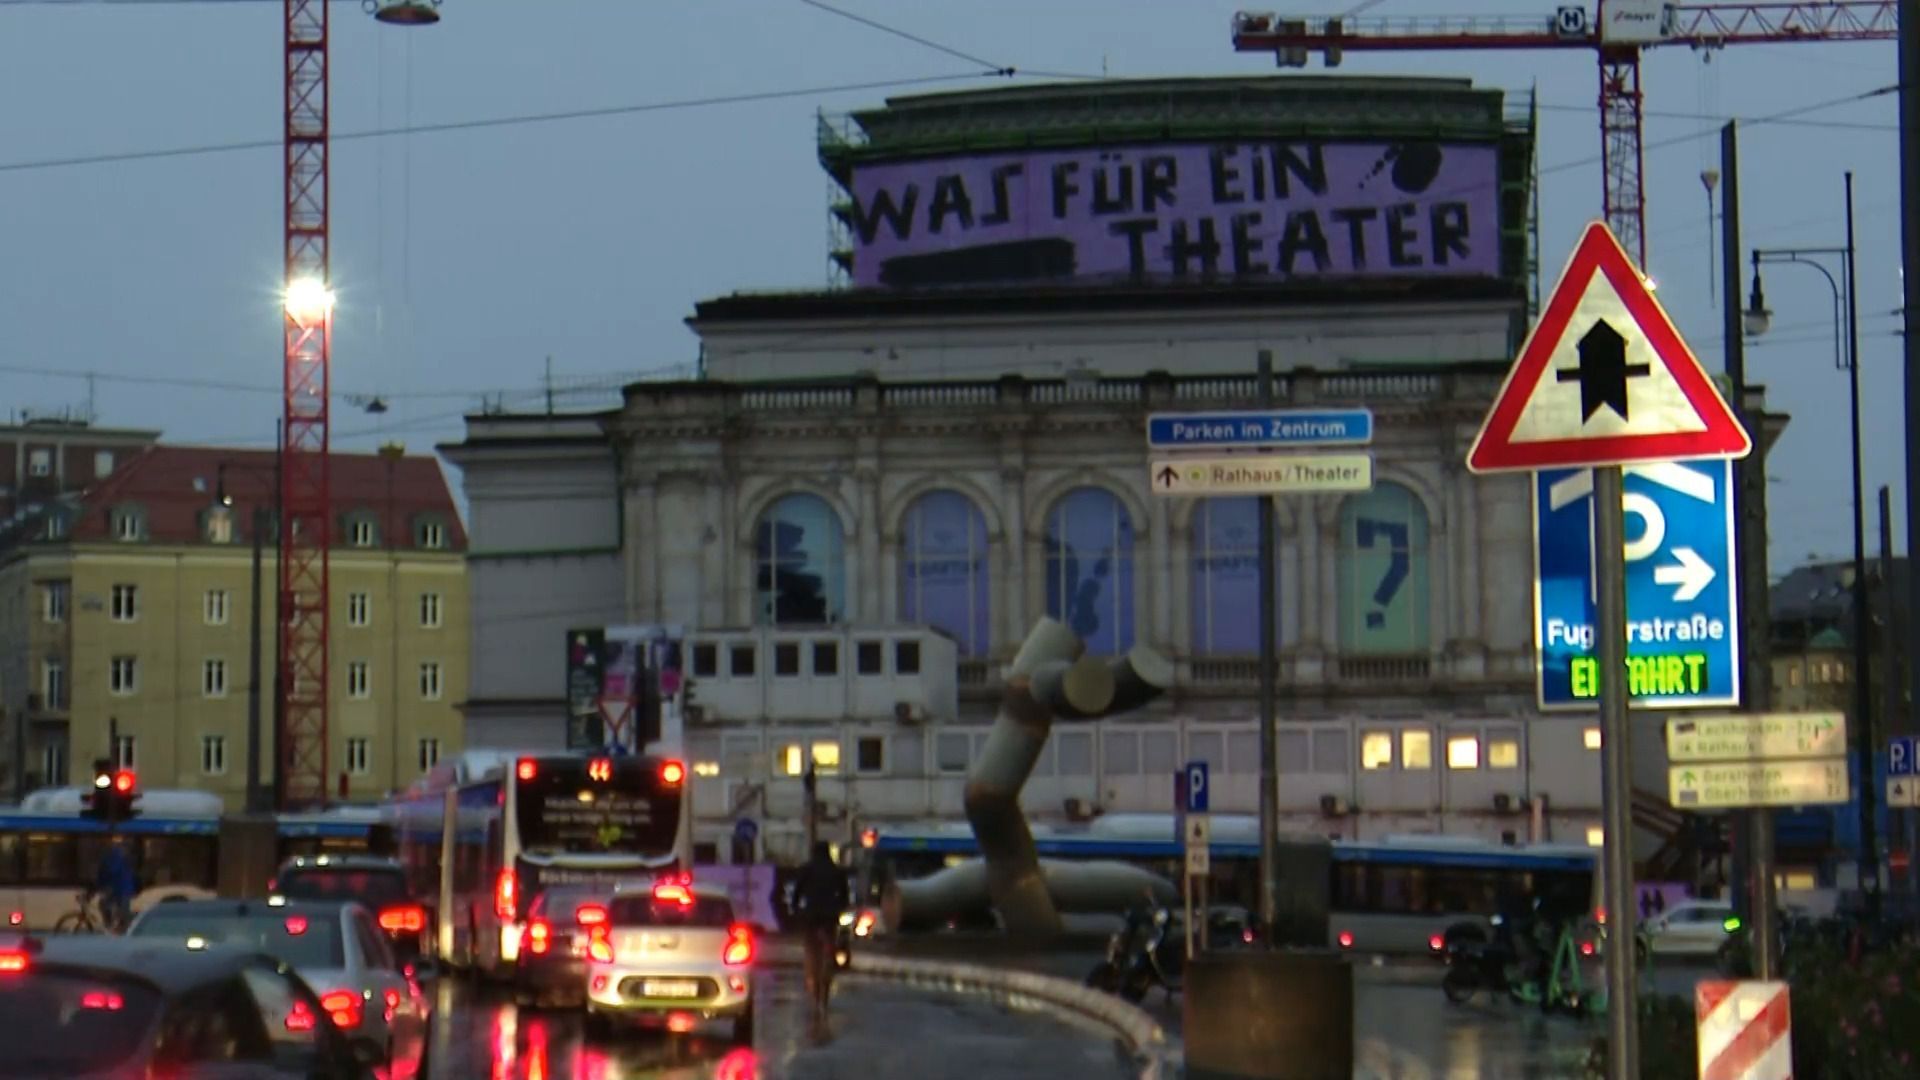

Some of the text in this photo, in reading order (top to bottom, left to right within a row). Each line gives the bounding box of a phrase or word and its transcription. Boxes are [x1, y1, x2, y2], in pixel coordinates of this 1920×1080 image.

[851, 163, 1023, 245] WAS
[1050, 154, 1179, 217] FÜR
[1107, 202, 1471, 278] THEATER
[1172, 421, 1347, 440] Parken im Zentrum
[1547, 613, 1724, 651] Fugrstraße
[1571, 653, 1706, 697] EIAHRT
[1190, 768, 1204, 809] P
